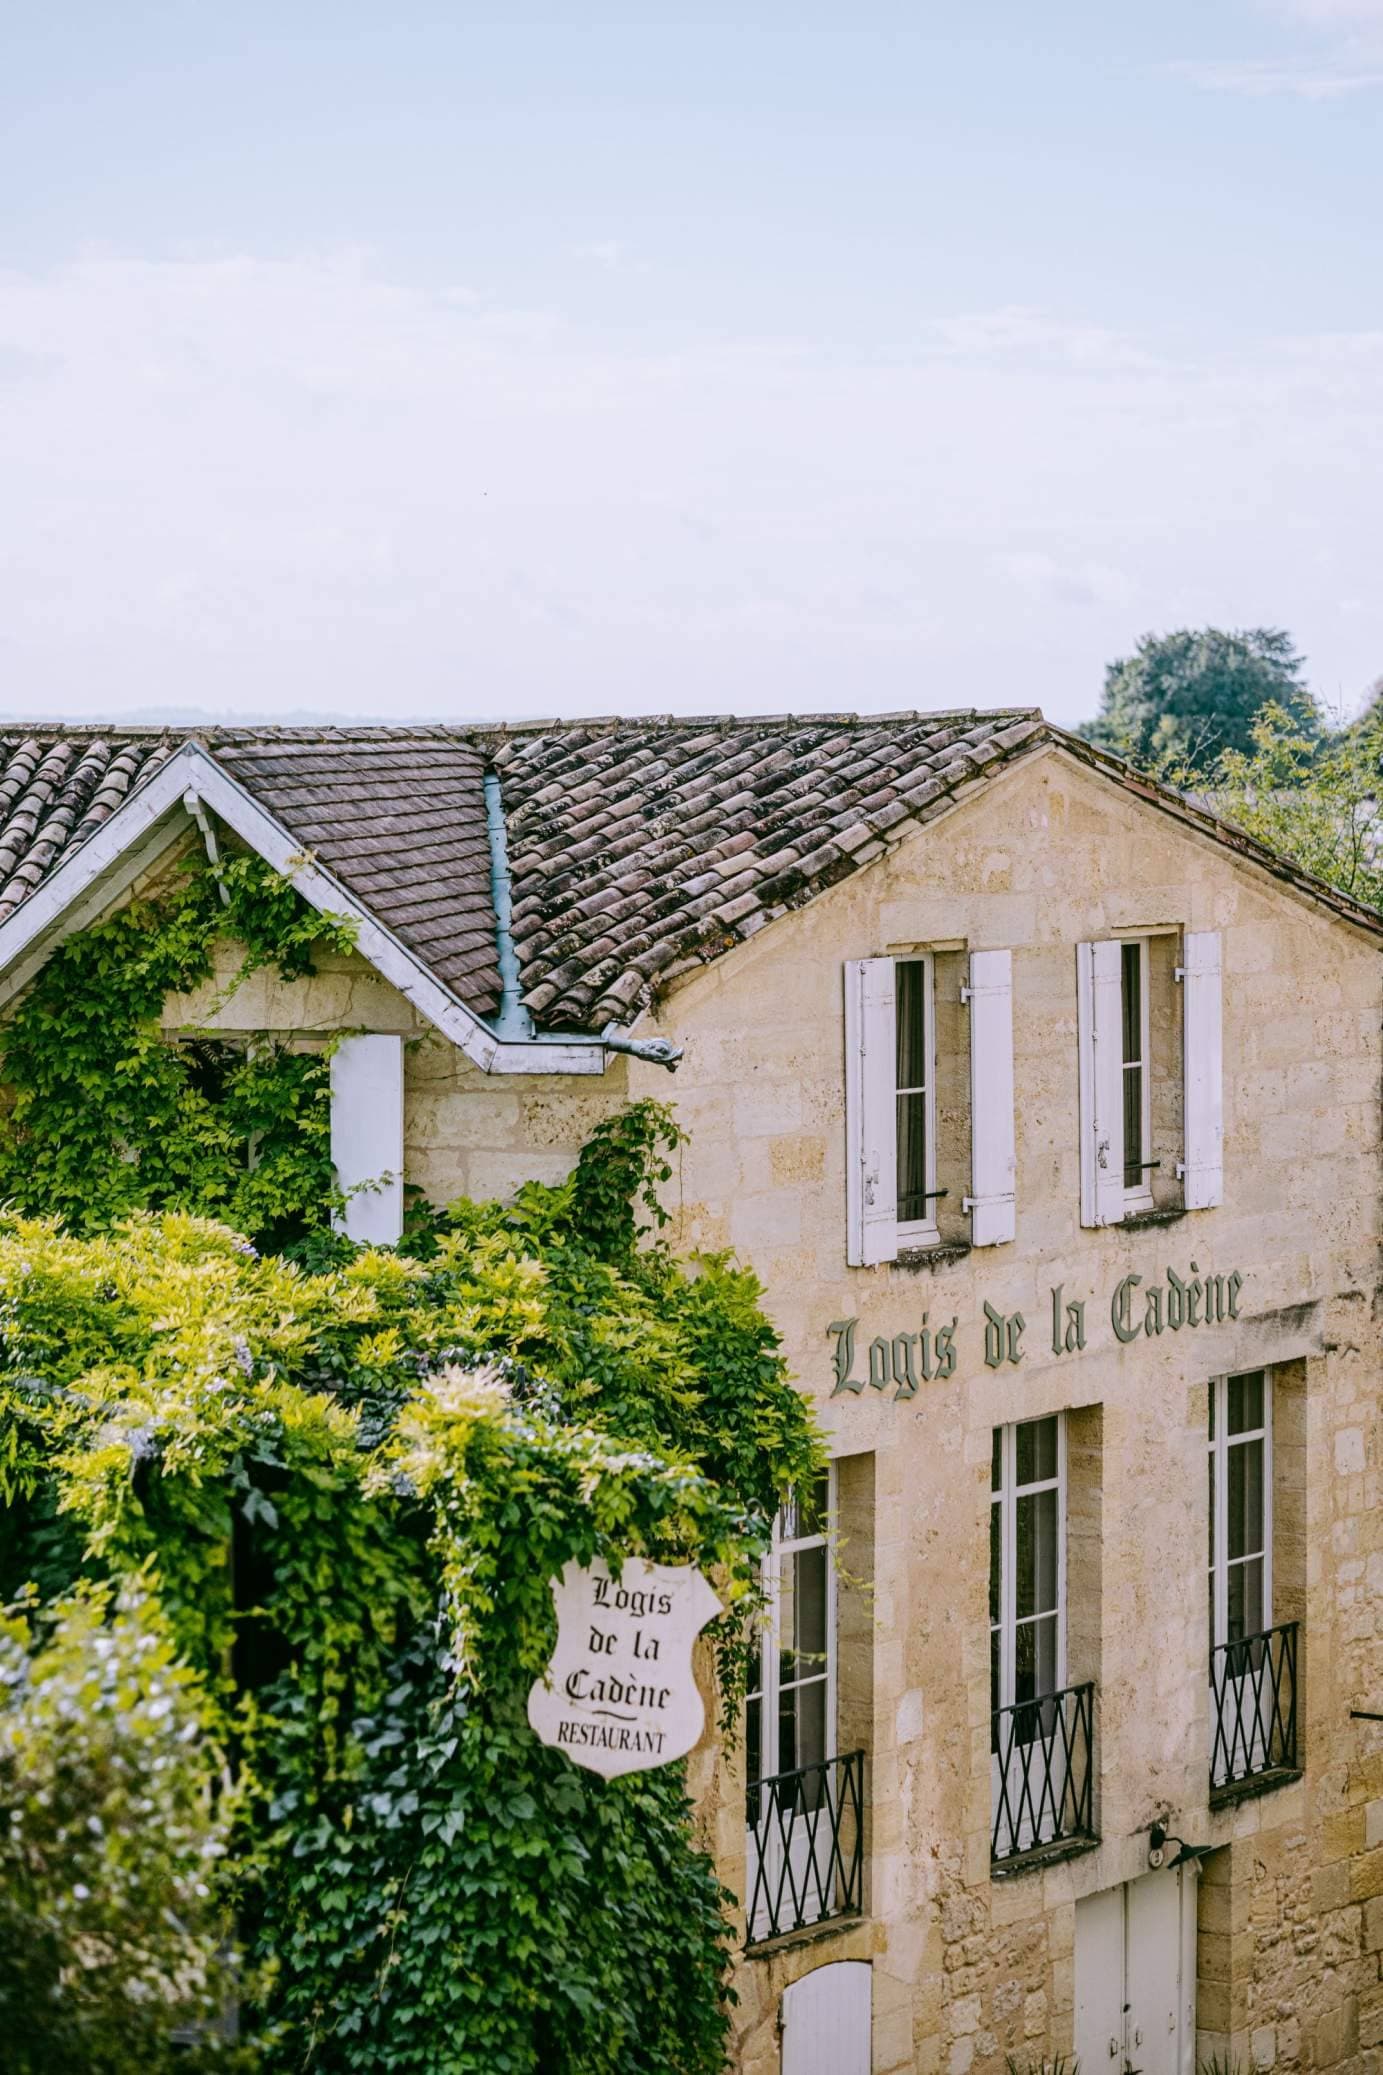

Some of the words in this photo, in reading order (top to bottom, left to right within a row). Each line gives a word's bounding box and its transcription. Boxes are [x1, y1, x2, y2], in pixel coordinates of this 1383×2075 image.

[826, 1312, 959, 1401] Logis
[983, 1299, 1026, 1369] de
[1050, 1283, 1087, 1356] la
[592, 1576, 672, 1617] Logis
[588, 1625, 618, 1655] de
[633, 1631, 660, 1661] la
[565, 1669, 671, 1709] Cadène
[557, 1720, 666, 1754] RESTAURANT
